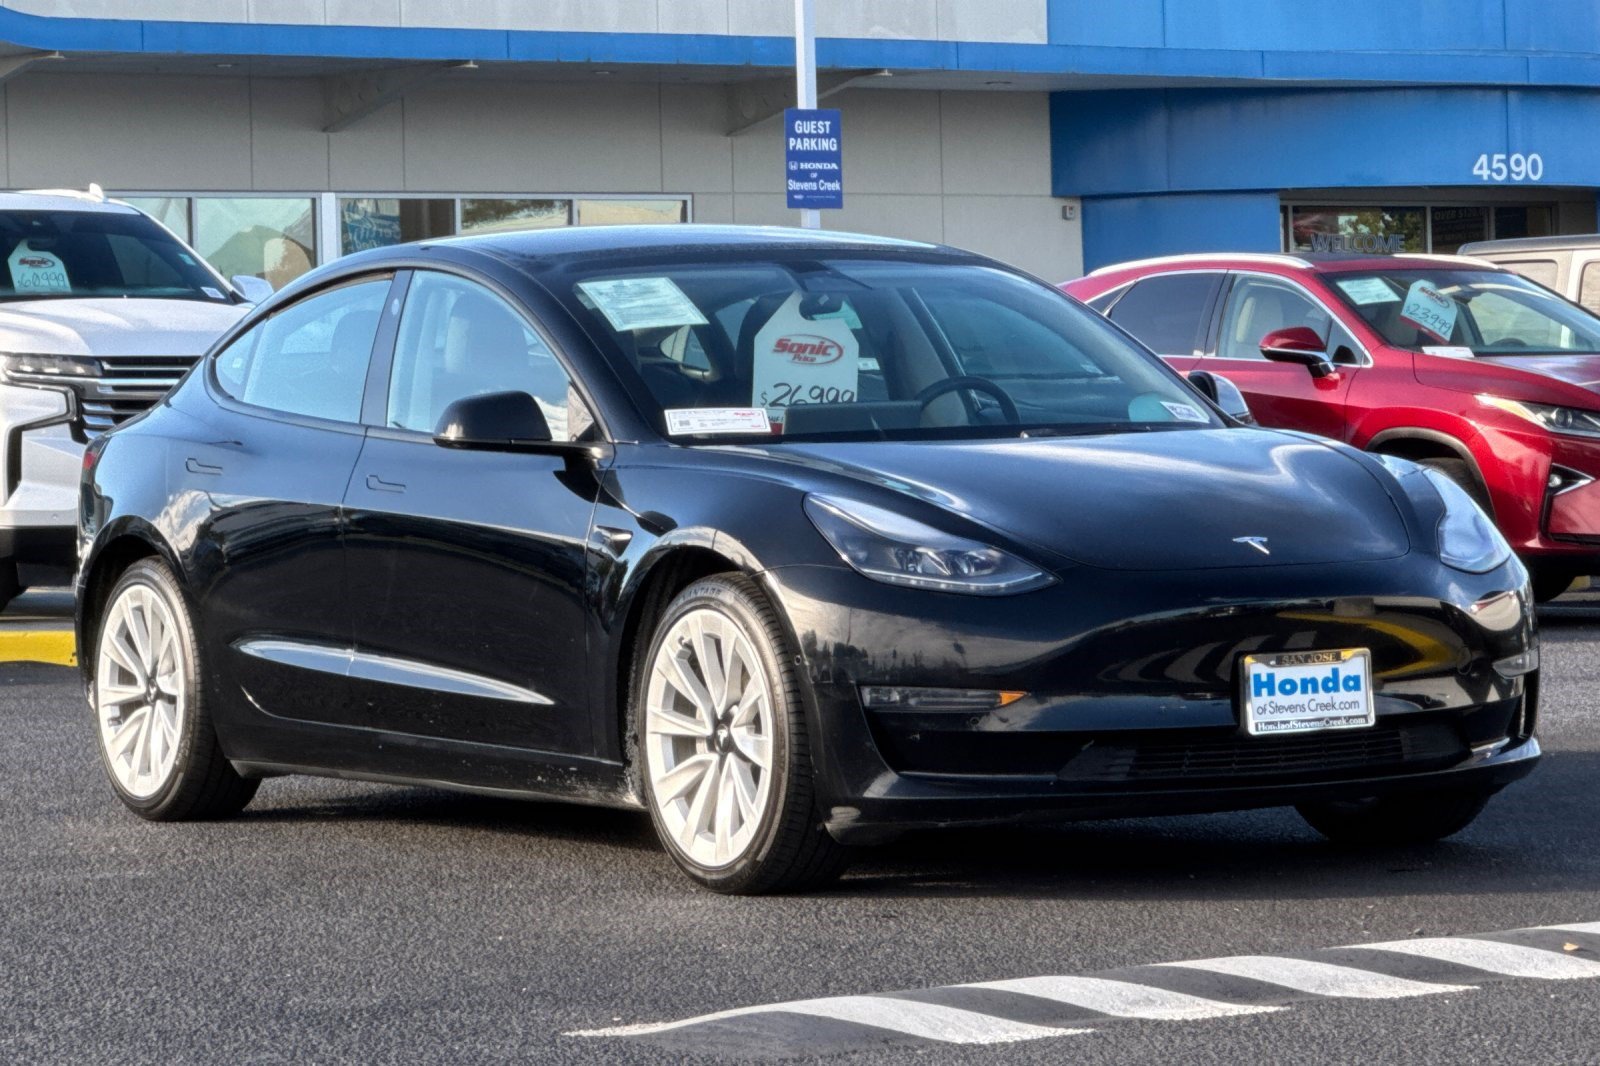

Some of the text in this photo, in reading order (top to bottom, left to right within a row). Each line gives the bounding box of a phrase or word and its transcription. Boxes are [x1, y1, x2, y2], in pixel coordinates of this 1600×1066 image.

[795, 120, 831, 134] GUEST
[789, 137, 838, 151] PARKING
[800, 162, 838, 170] HONDA
[1472, 153, 1543, 181] 4590
[788, 179, 841, 191] Stevens Creek
[1310, 232, 1405, 253] WELCOME
[773, 338, 835, 356] Sonic
[792, 354, 816, 362] Price
[1282, 652, 1337, 665] SAN JOSE
[1253, 667, 1361, 697] Honda
[1257, 696, 1360, 715] of Stevens Creek.com
[1257, 717, 1366, 731] HondaofStevensCreek.com
